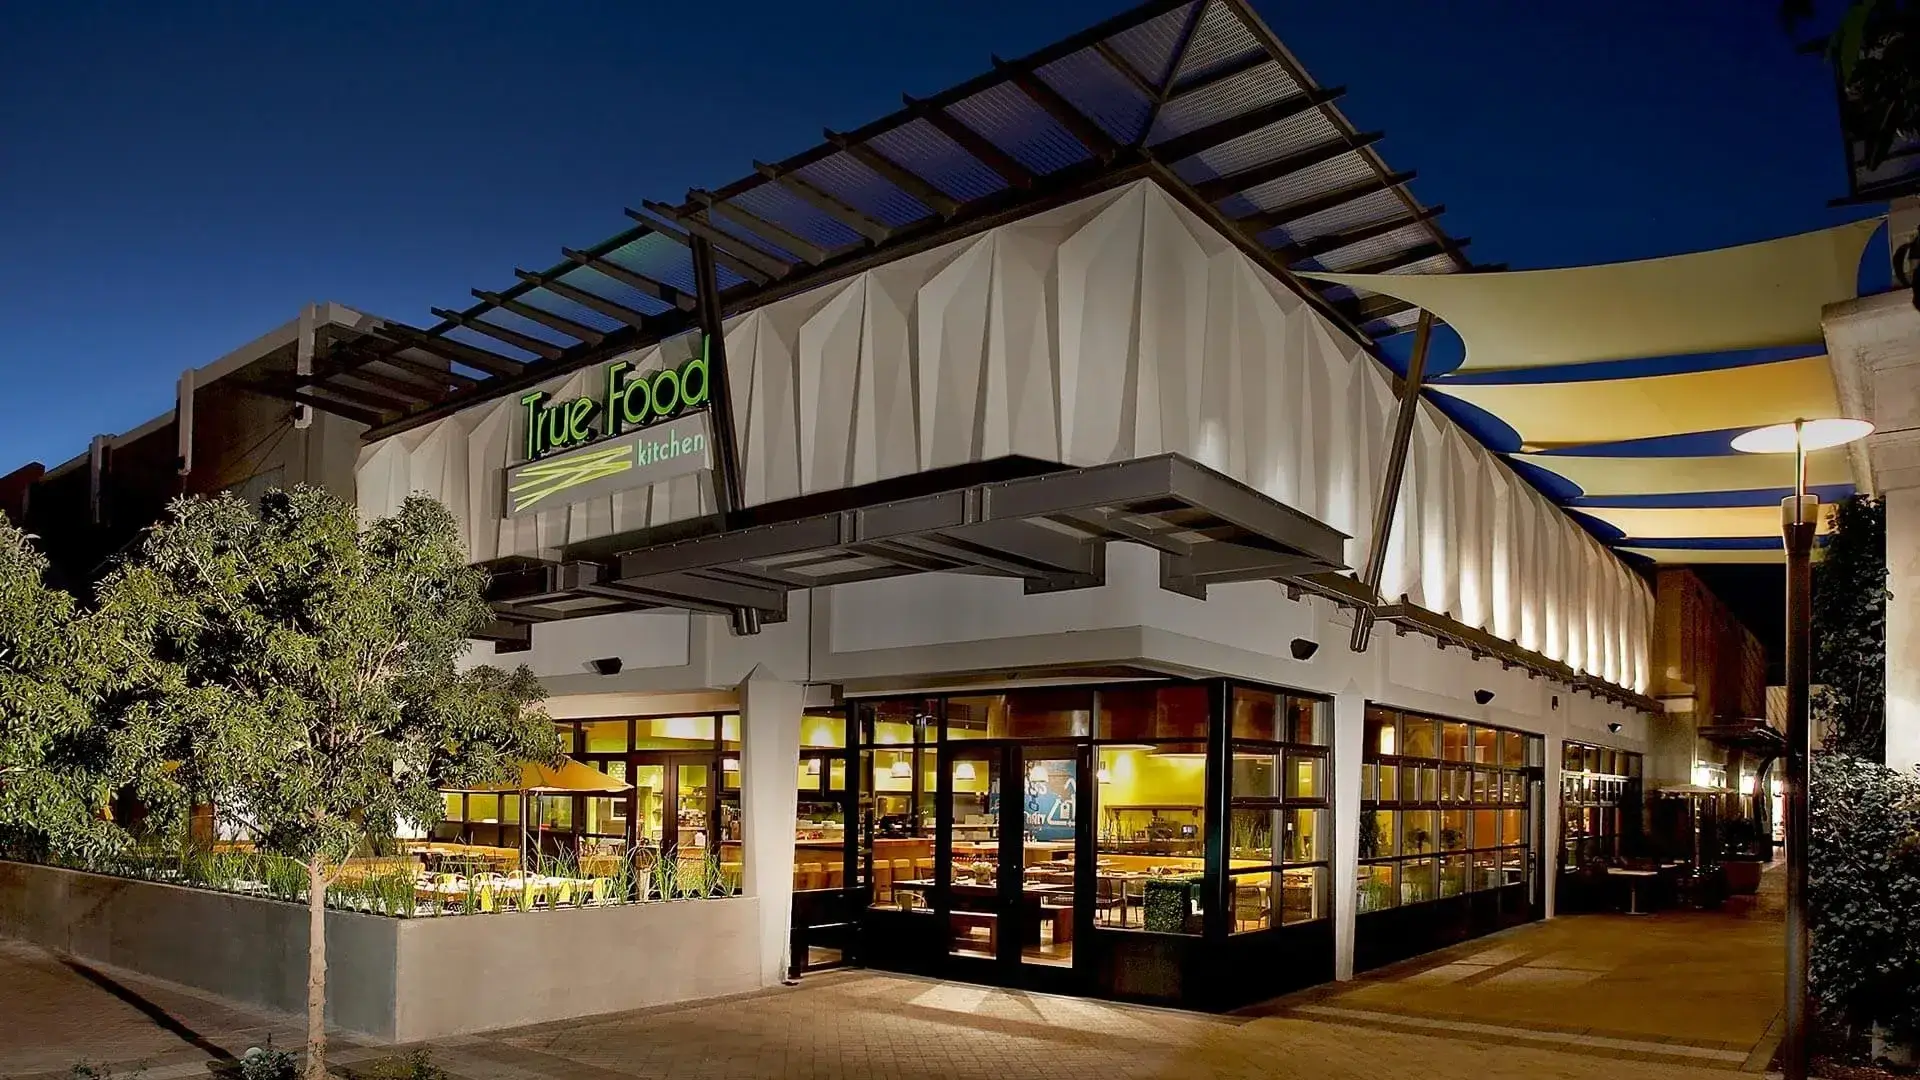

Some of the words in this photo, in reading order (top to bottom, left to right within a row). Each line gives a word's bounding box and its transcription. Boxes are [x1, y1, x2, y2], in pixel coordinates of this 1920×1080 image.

[521, 391, 593, 460] True
[607, 334, 711, 436] Food
[637, 428, 704, 466] kitchen
